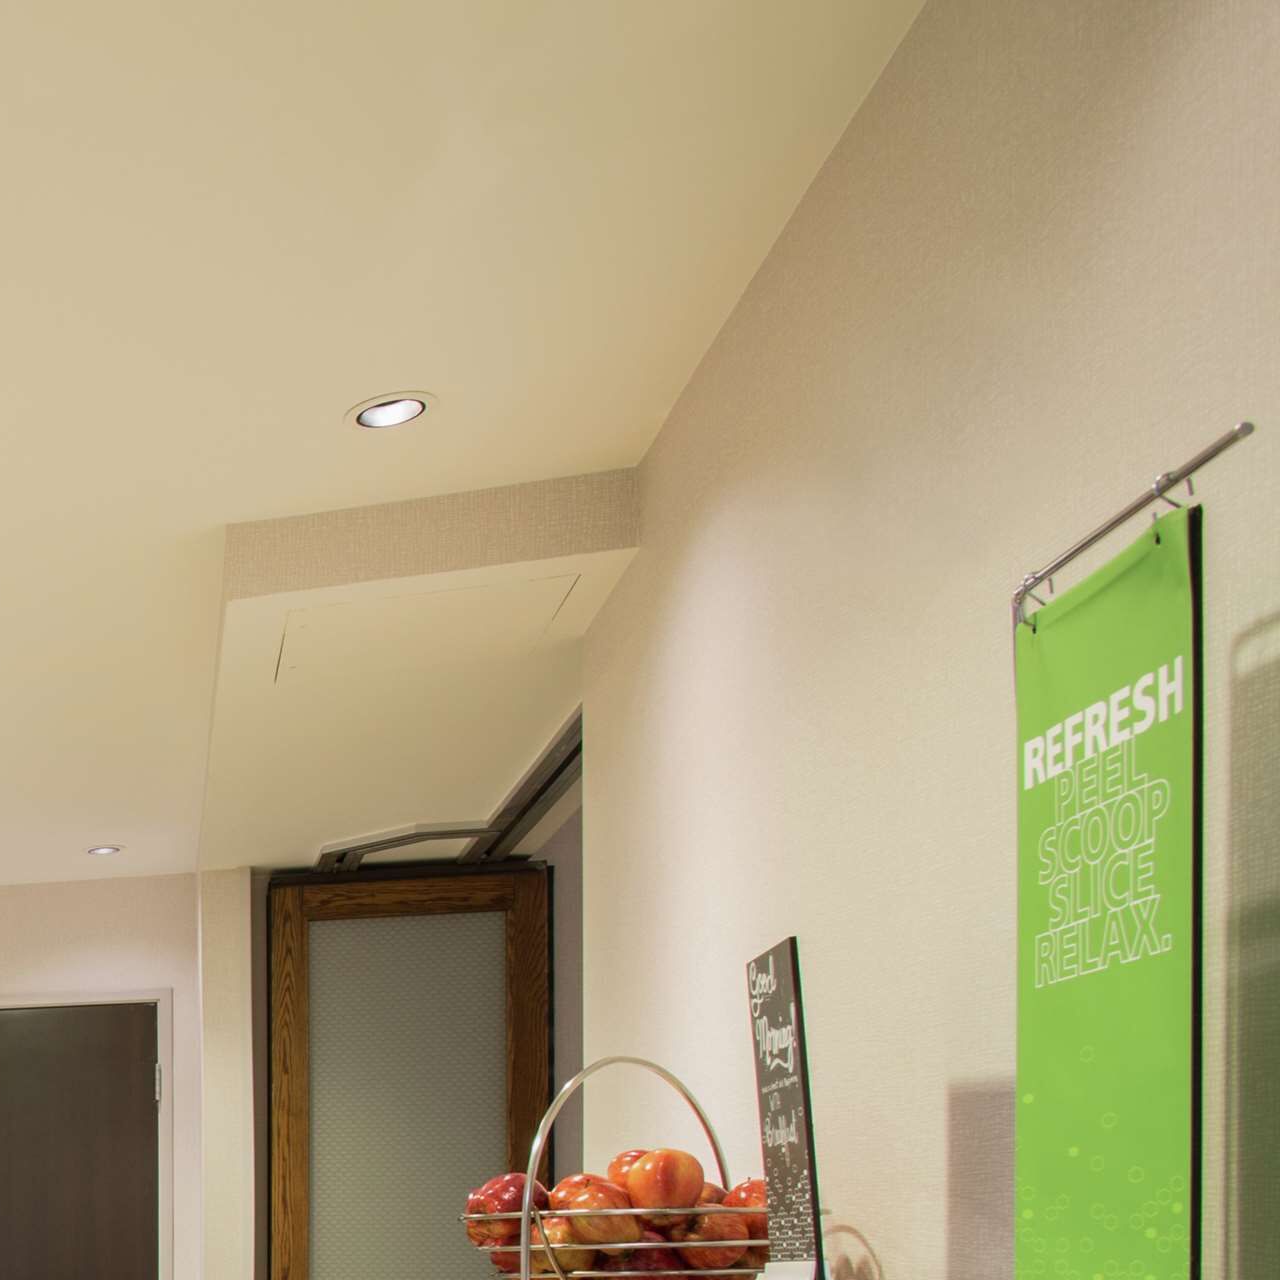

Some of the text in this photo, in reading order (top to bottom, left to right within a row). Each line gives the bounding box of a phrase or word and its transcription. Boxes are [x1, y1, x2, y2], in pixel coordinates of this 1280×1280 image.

[1023, 655, 1184, 790] REFRESH
[1054, 734, 1148, 827] PEEL
[1038, 778, 1171, 886] SCOOP
[1049, 838, 1155, 933] SLICE
[1034, 894, 1173, 989] RELAX.
